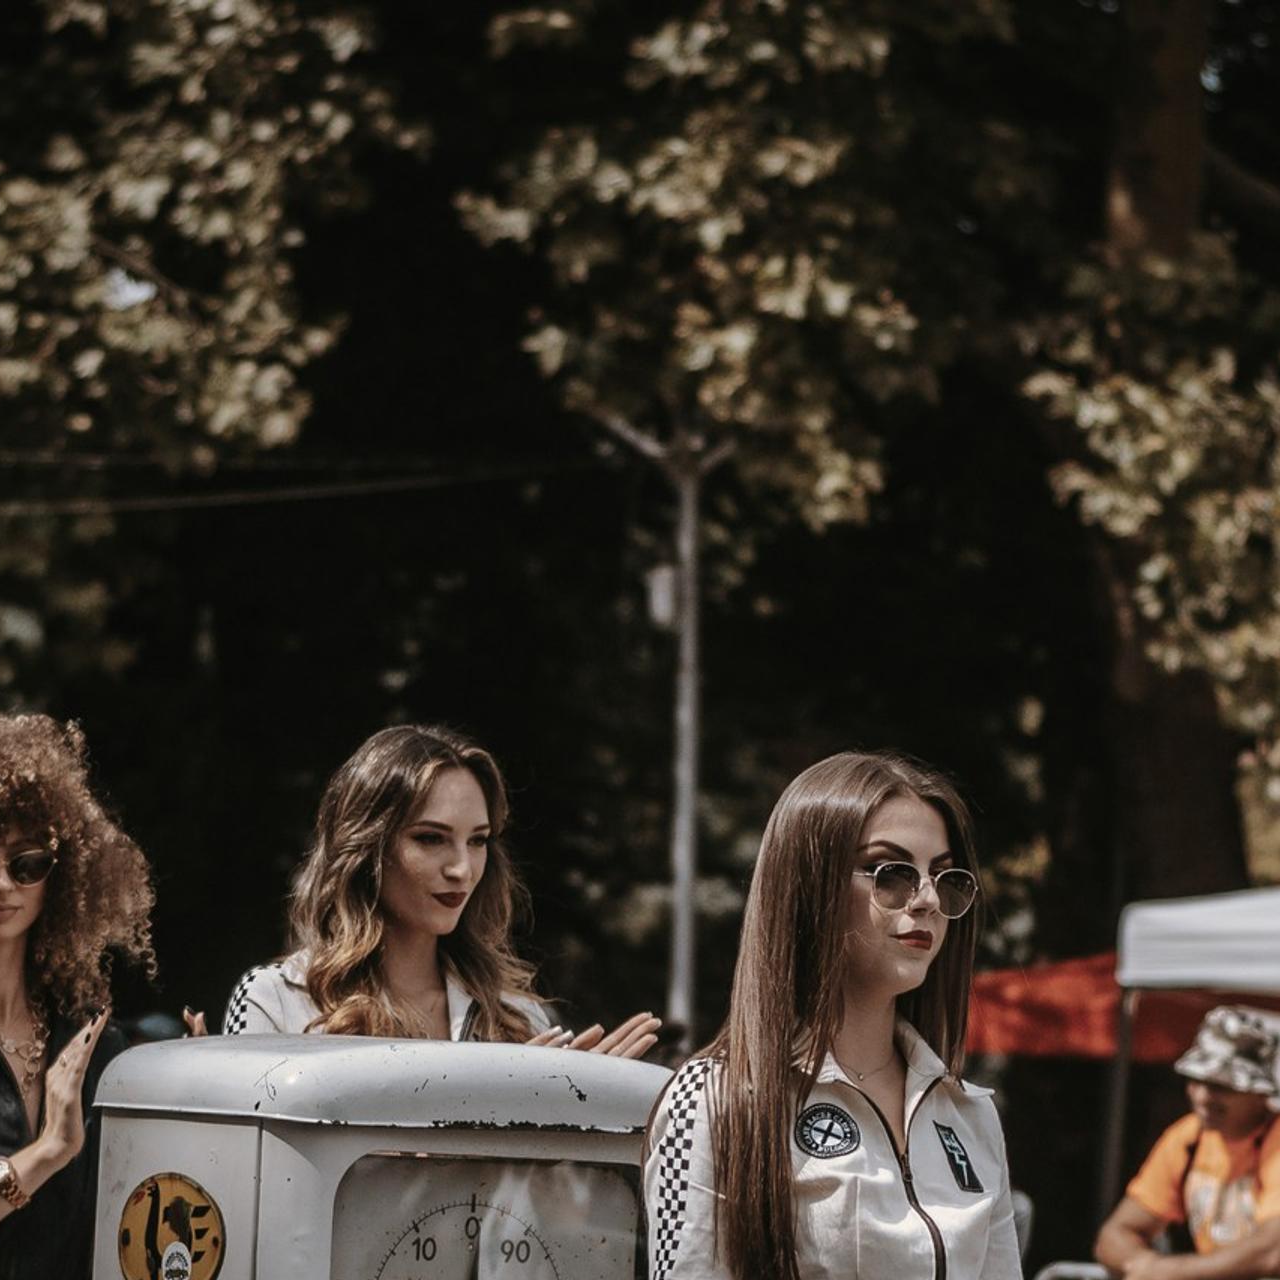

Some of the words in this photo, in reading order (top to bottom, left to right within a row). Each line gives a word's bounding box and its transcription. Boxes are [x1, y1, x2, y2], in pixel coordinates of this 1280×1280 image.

[465, 1216, 480, 1239] 0
[412, 1238, 437, 1261] 10
[501, 1240, 531, 1263] 90
